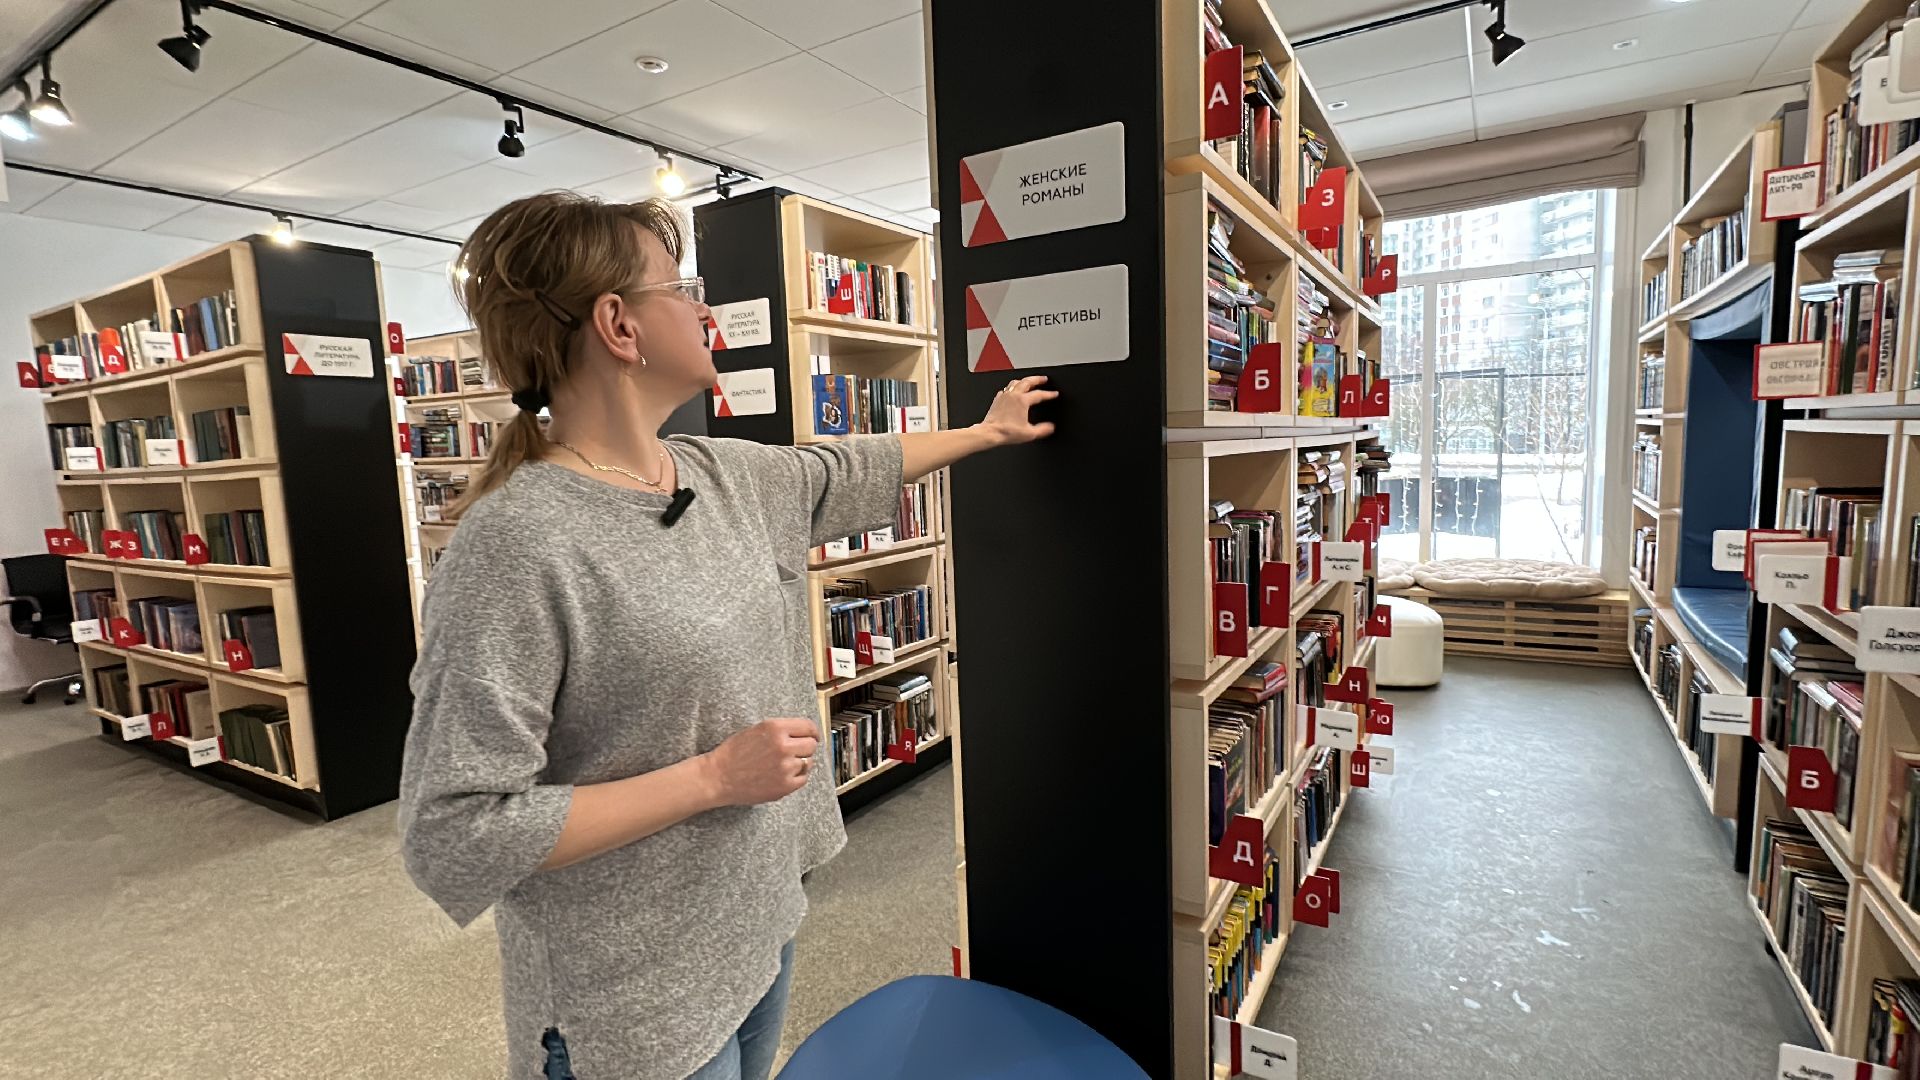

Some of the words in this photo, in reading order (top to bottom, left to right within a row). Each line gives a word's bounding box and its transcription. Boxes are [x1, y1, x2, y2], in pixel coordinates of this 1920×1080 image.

[1207, 82, 1229, 110] А
[1019, 163, 1087, 188] ЖЕНСКИЕ
[1022, 183, 1085, 206] РОМАНЫ
[1381, 269, 1391, 281] Р
[841, 287, 852, 301] Ш
[1017, 308, 1101, 331] ДЕТЕКТИВЫ
[1254, 369, 1270, 390] Б
[1342, 390, 1354, 404] Л
[1374, 392, 1384, 405] С
[189, 545, 201, 555] М
[1266, 585, 1279, 606] Г
[1219, 610, 1237, 632] В
[1376, 615, 1387, 627] Ч
[119, 629, 129, 639] К
[231, 650, 243, 661] Н
[1348, 679, 1361, 692] Н
[1376, 714, 1390, 725] Ю
[904, 740, 912, 751] Я
[1800, 770, 1820, 789] Б
[1233, 840, 1254, 866] Д
[1305, 893, 1321, 909] О
